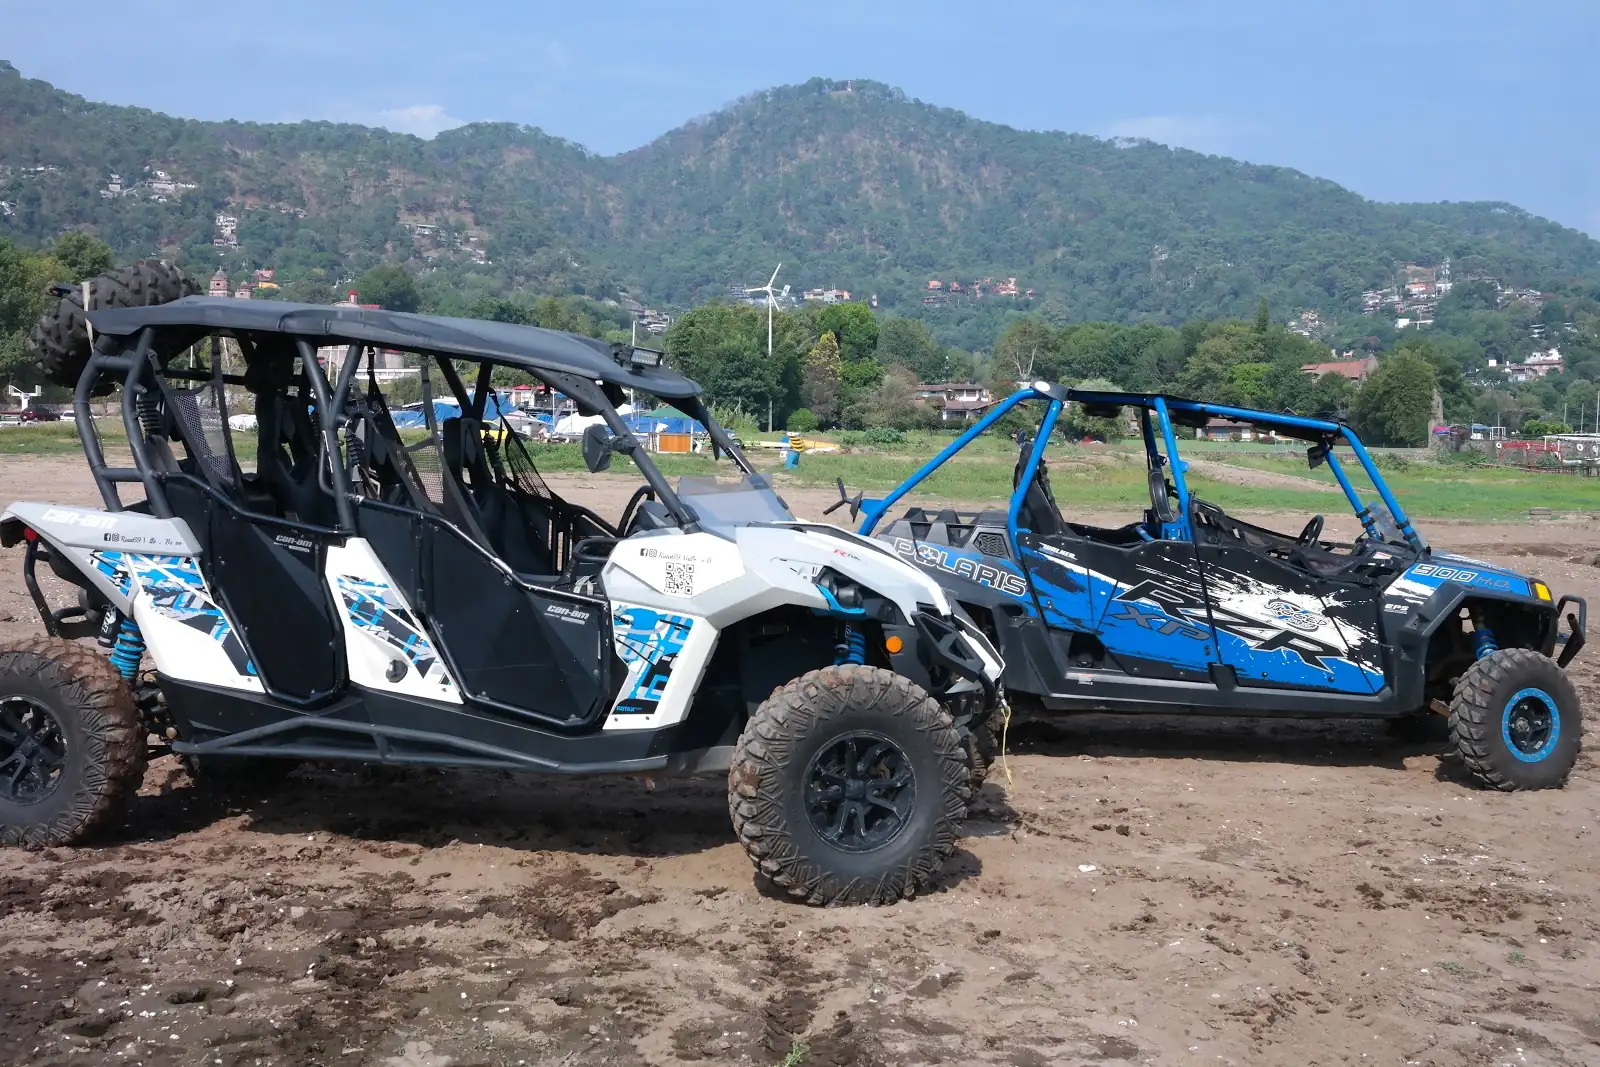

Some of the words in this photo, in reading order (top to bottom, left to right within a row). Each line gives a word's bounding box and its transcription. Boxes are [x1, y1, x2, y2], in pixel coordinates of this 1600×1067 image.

[893, 537, 1027, 597] POLARIS
[1411, 563, 1479, 583] 900
[1109, 605, 1212, 641] XP
